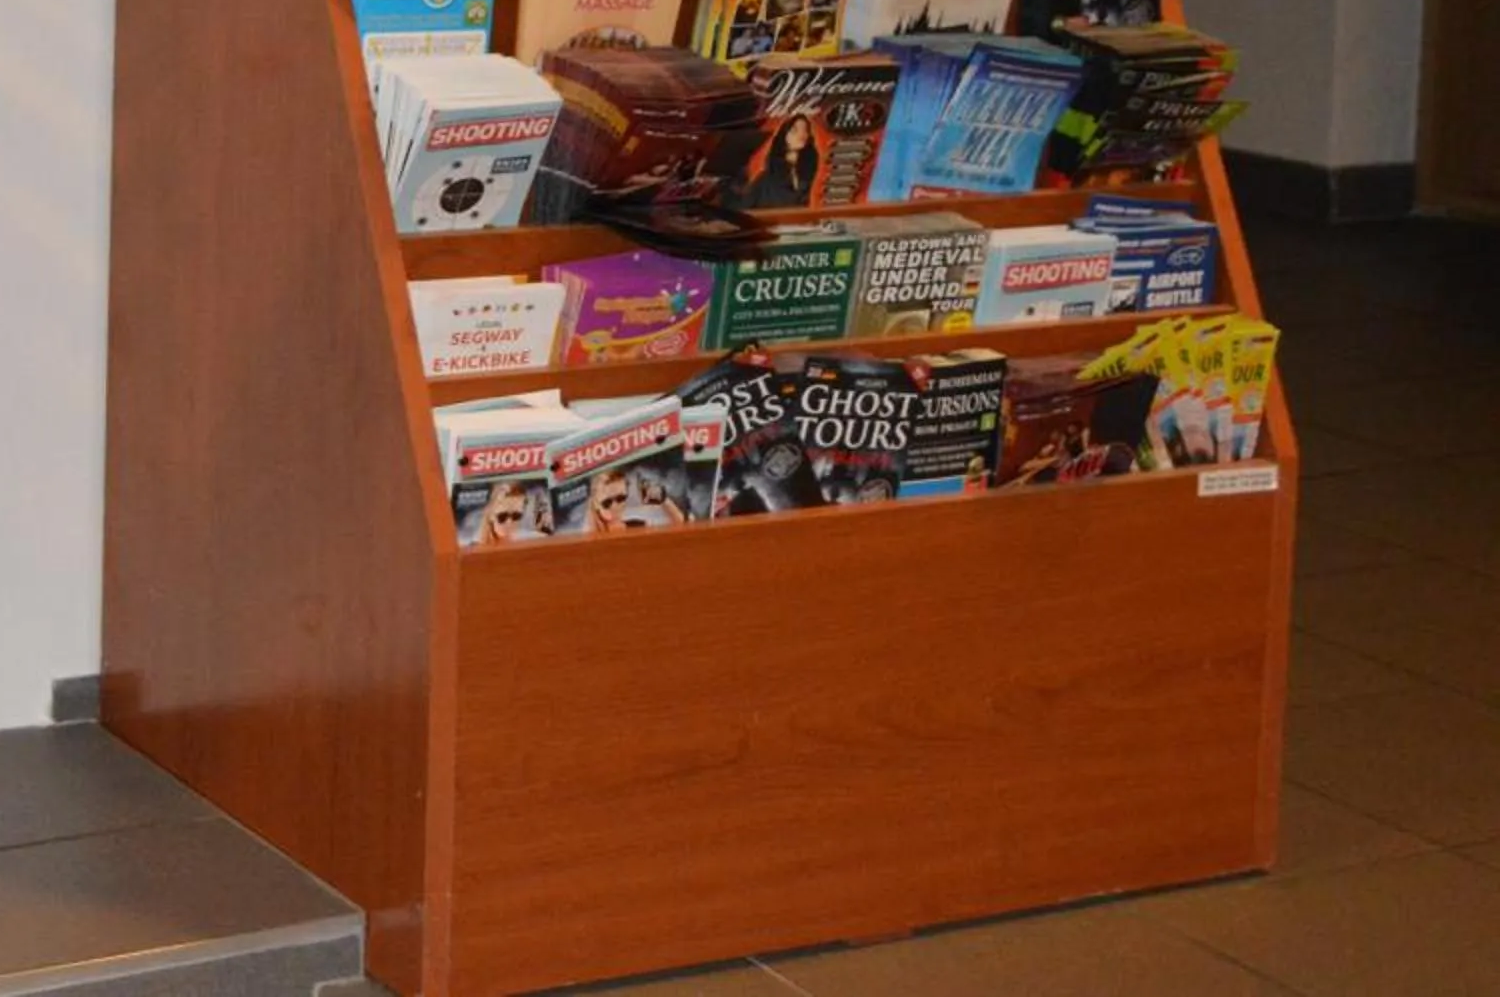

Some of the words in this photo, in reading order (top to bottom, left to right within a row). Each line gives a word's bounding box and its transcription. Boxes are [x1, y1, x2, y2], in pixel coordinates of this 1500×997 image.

[760, 66, 896, 115] Welcome
[430, 118, 550, 147] SHOOTING
[877, 238, 952, 252] OLDTOWN
[956, 234, 986, 246] AND
[762, 252, 830, 271] DINNER
[874, 247, 984, 269] MEDIEVAL
[871, 267, 948, 286] UNDER
[1006, 258, 1107, 286] SHOOTING
[1147, 271, 1204, 289] AIRPORT
[735, 273, 848, 302] CRUISES
[866, 283, 959, 304] GROUND
[1146, 289, 1203, 308] SHUTTLE
[931, 299, 974, 312] TOUR
[451, 328, 524, 346] SEGWAY
[433, 350, 531, 372] E-KICKBIKE
[938, 371, 1001, 390] BOHEMIAN
[707, 373, 773, 413] OST
[801, 384, 918, 419] GHOST
[916, 389, 1000, 420] URSIONS
[794, 415, 910, 451] TOURS
[562, 419, 671, 474] SHOOTING
[470, 447, 547, 473] SHOOT
